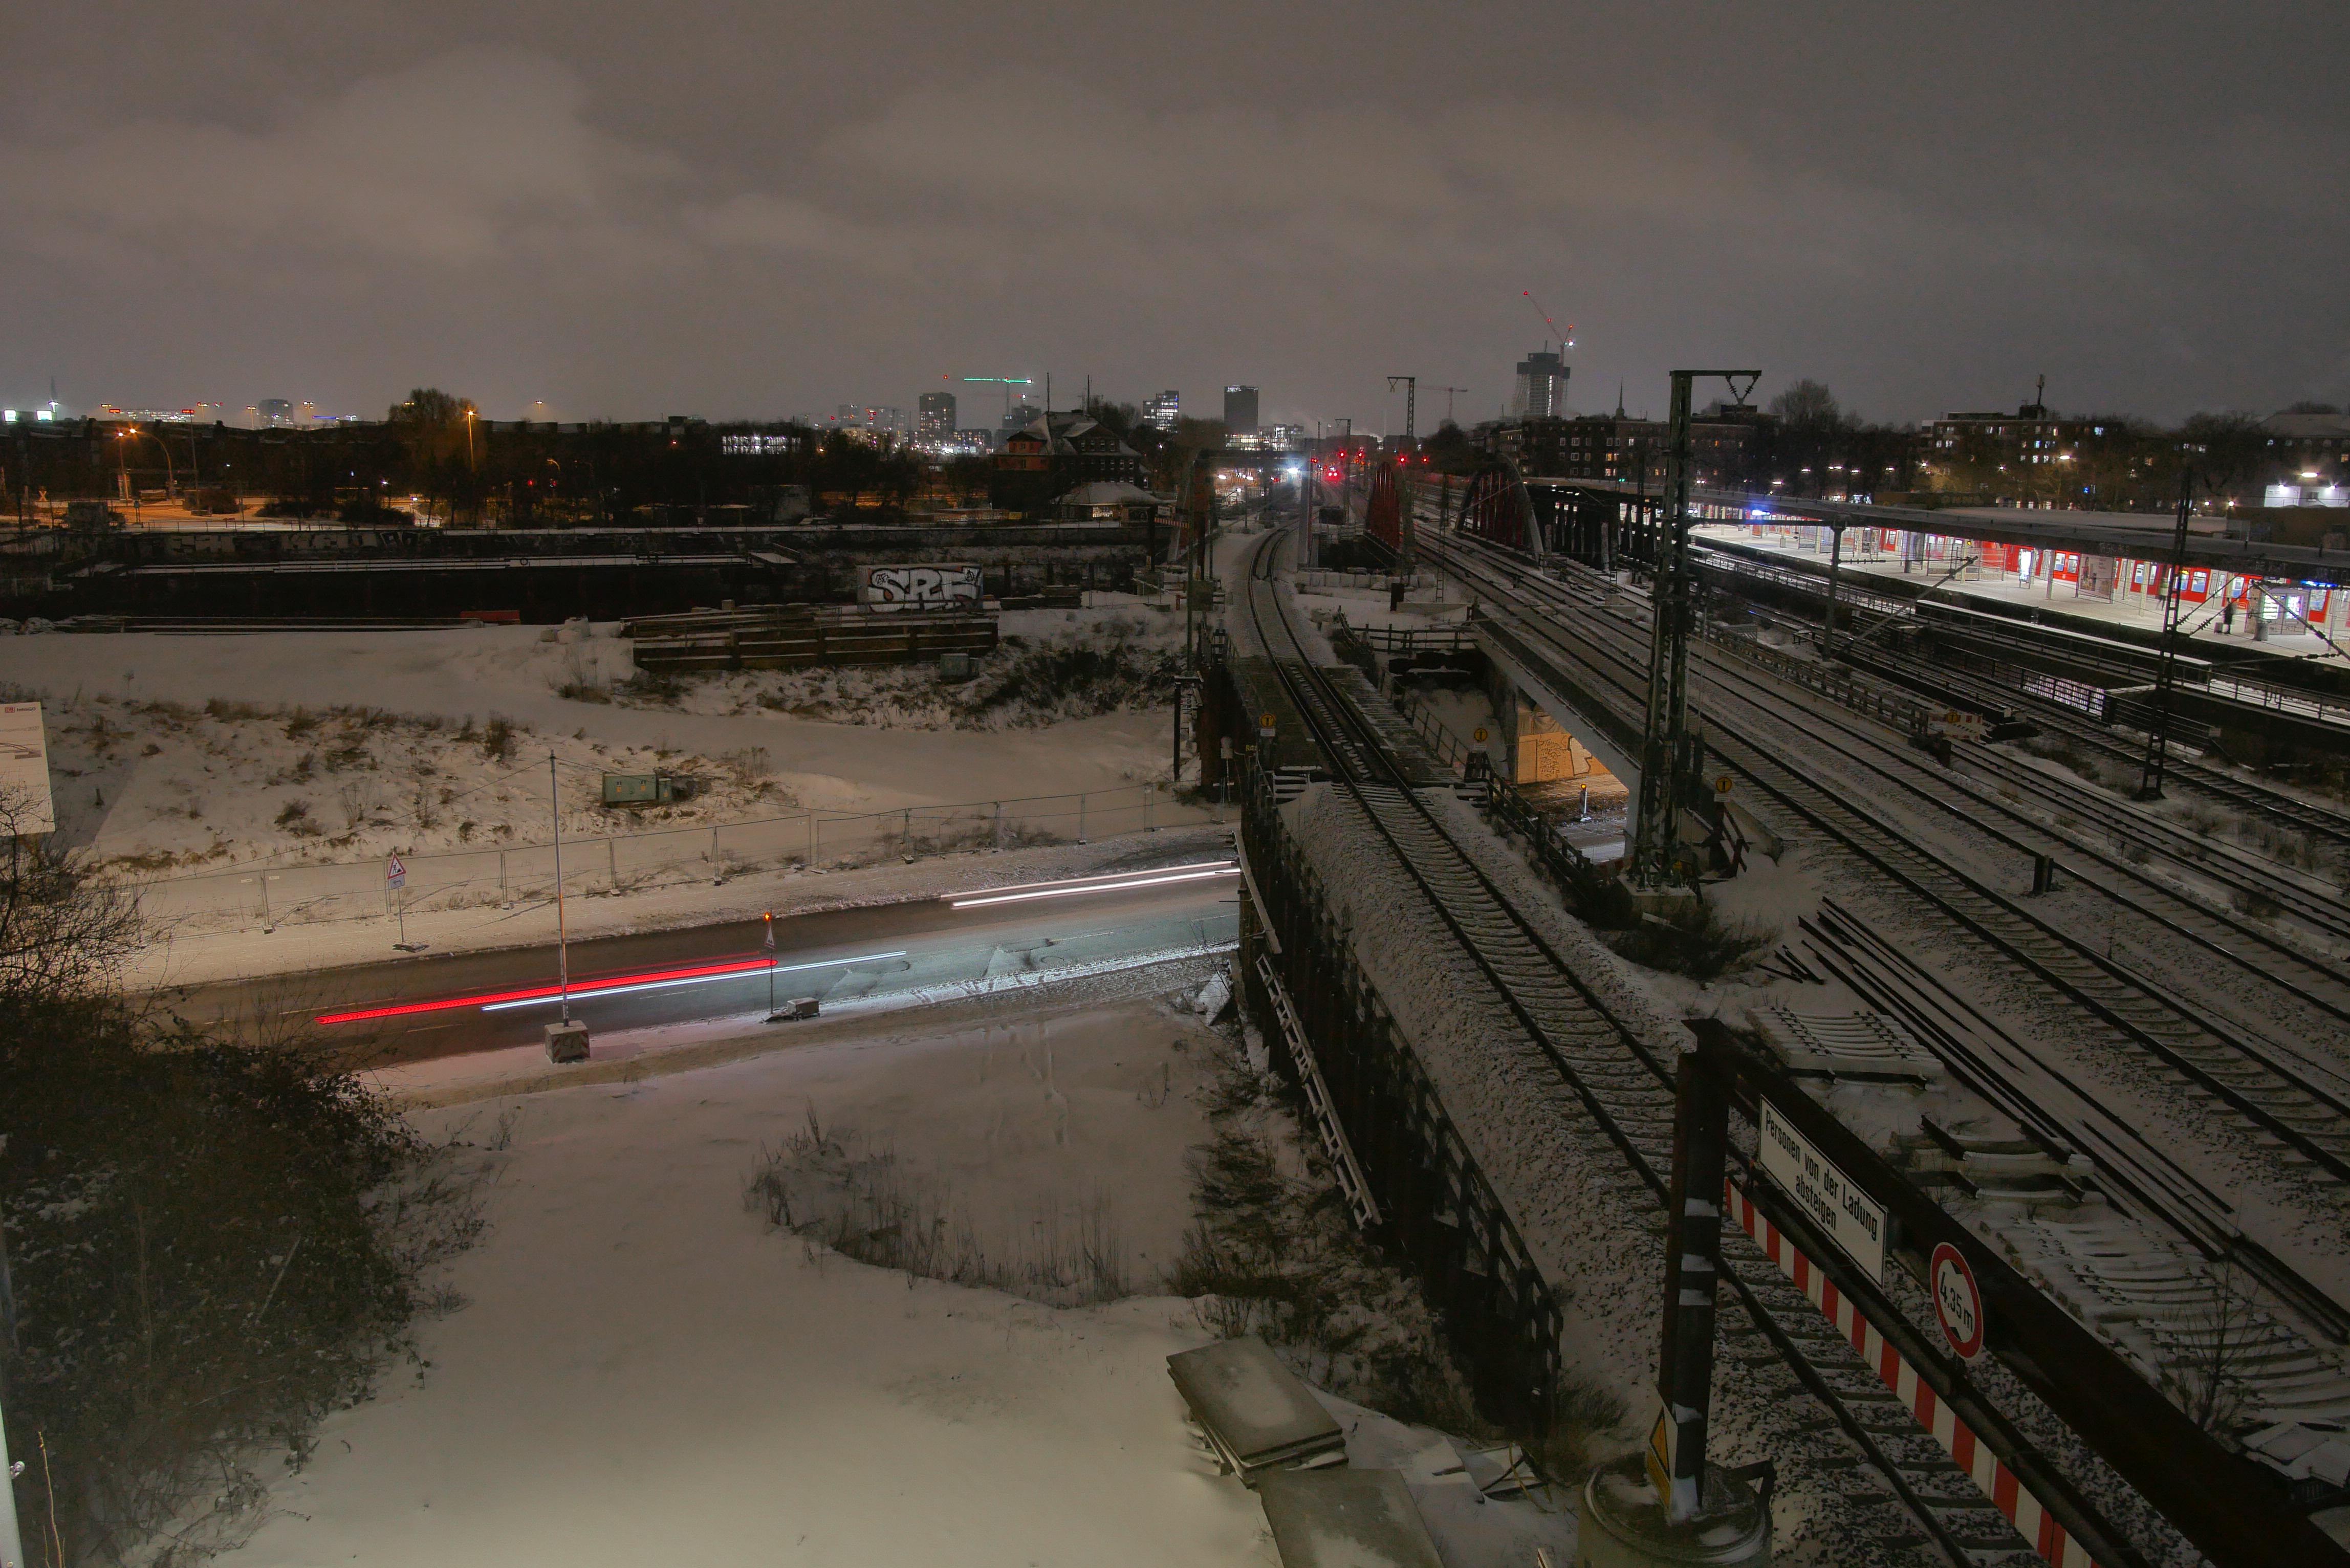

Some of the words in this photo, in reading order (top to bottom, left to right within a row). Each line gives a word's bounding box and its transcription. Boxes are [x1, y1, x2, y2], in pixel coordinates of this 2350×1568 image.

[1766, 1109, 1800, 1163] Personen
[1804, 1153, 1819, 1182] von
[1824, 1169, 1839, 1199] der
[1842, 1184, 1878, 1242] Ladung
[1796, 1174, 1836, 1230] absteigen
